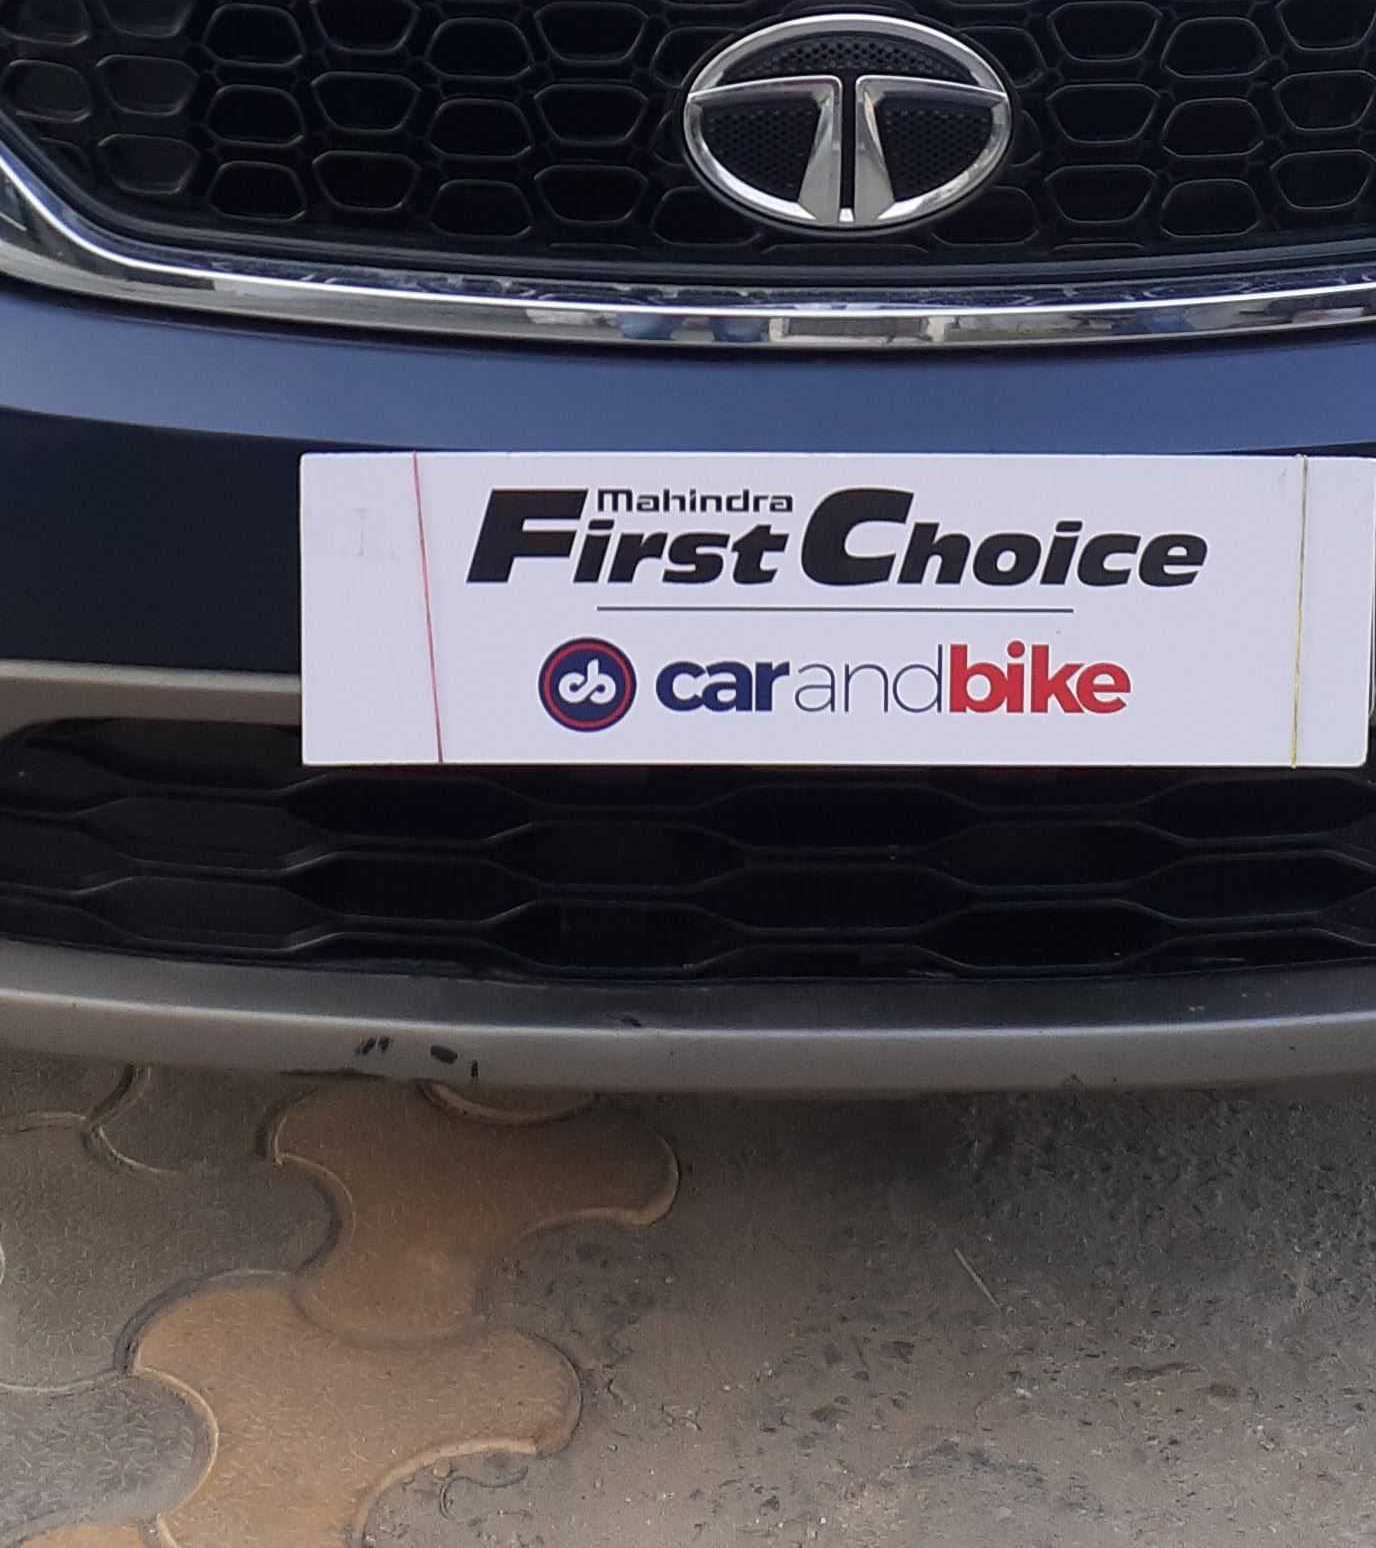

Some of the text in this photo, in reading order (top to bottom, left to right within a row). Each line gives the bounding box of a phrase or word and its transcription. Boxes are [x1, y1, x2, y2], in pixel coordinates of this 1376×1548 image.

[597, 488, 793, 513] Mahindra
[465, 486, 1208, 587] First Choice
